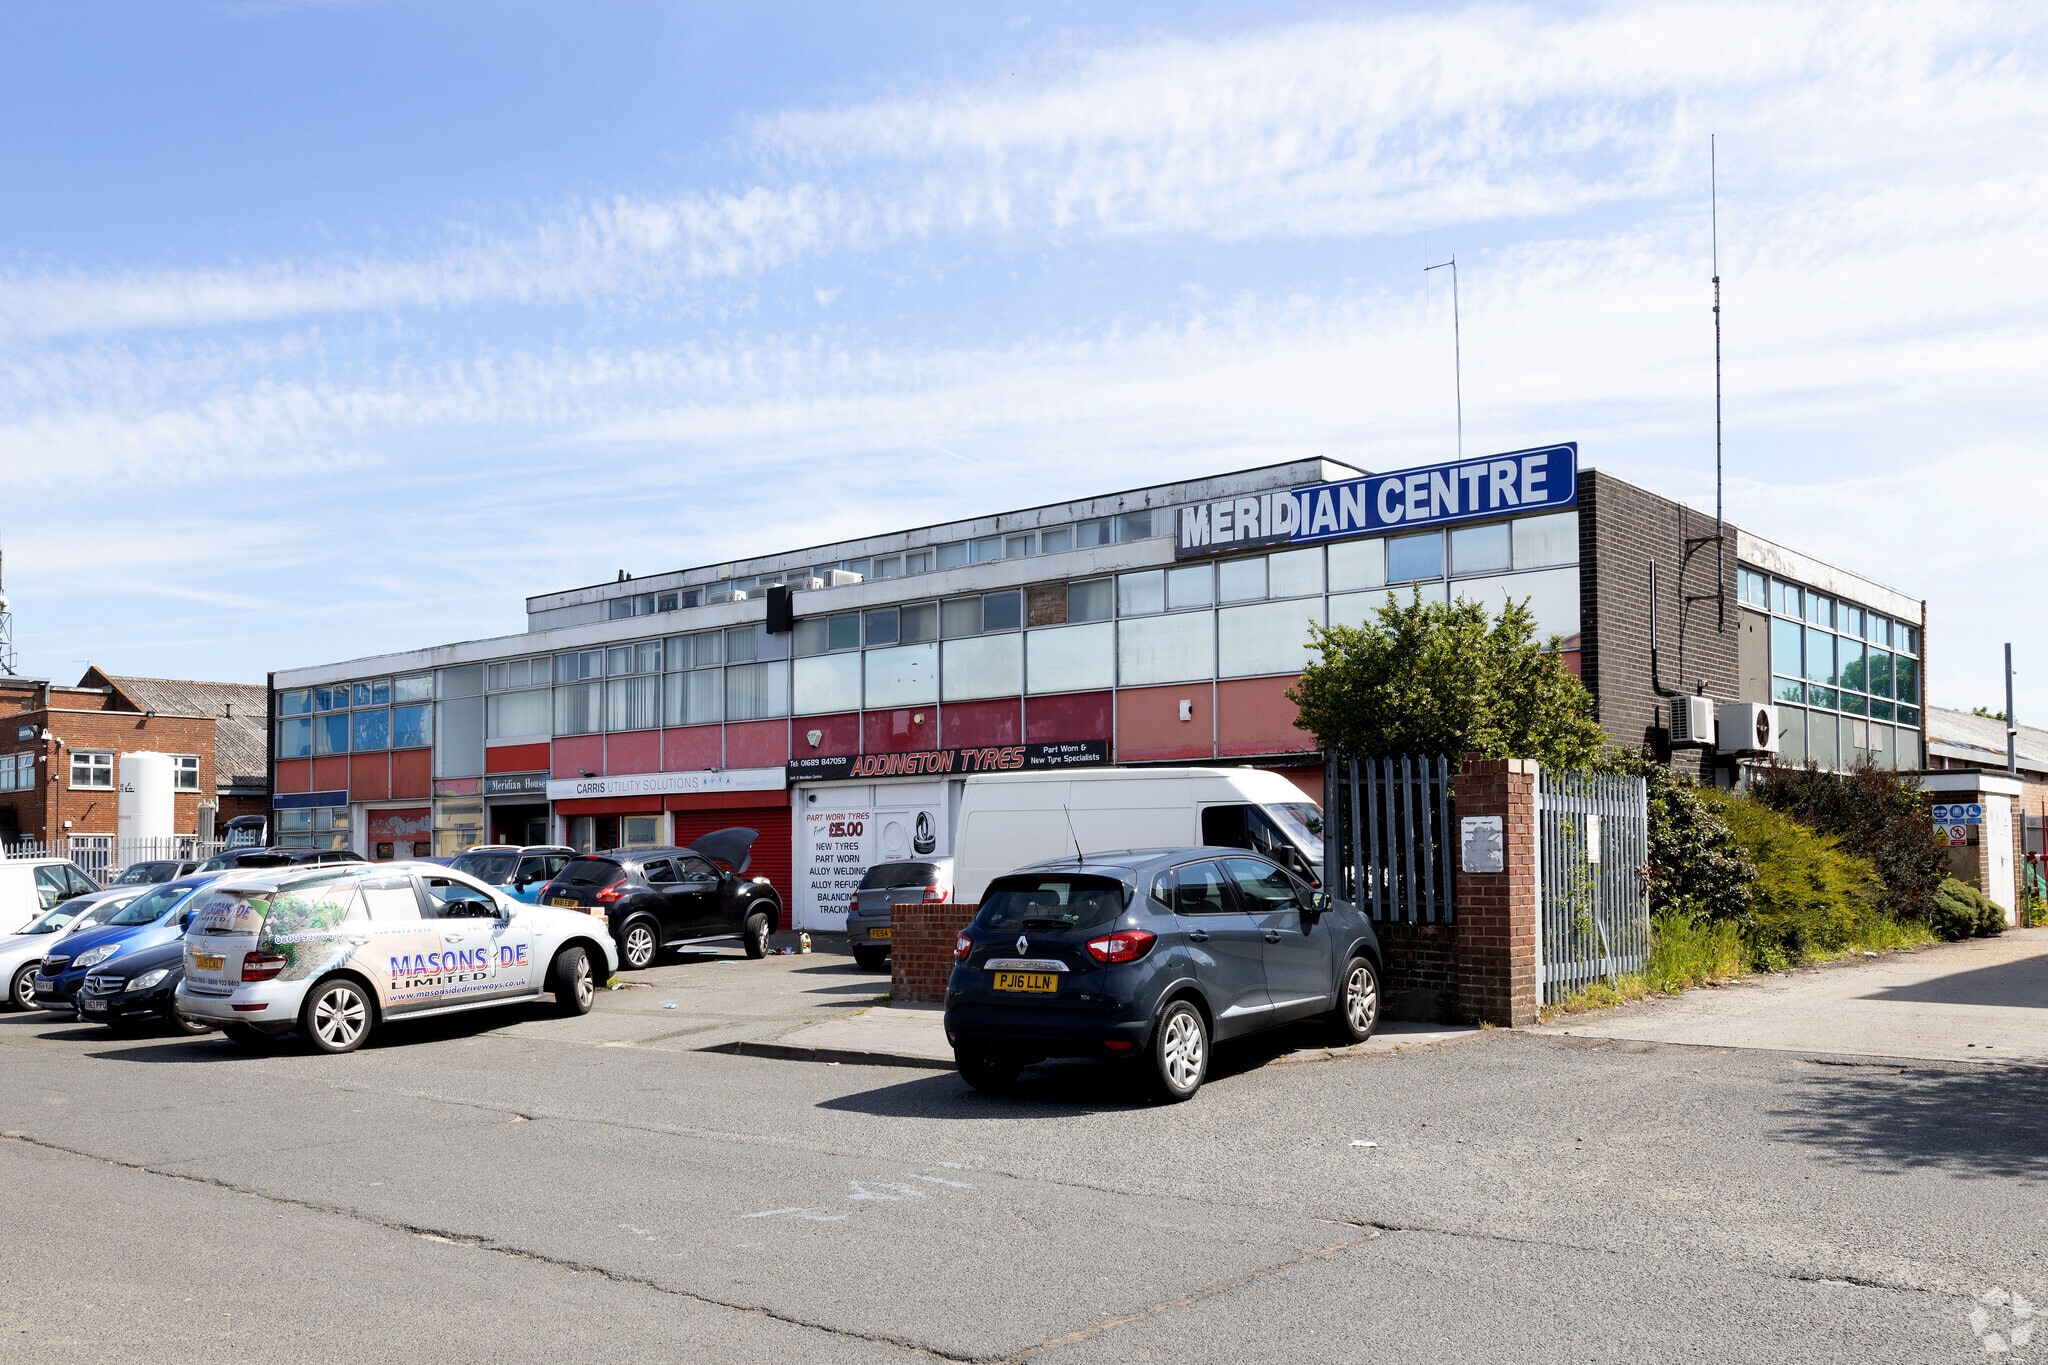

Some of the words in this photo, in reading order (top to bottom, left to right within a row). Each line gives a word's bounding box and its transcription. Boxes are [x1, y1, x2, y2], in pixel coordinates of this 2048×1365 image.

[1181, 483, 1368, 549] MERIDIAN
[1377, 454, 1549, 524] CENTRE
[1043, 746, 1059, 754] Part
[800, 758, 819, 767] 01689
[821, 757, 846, 766] 847059
[850, 751, 955, 776] ADDINGTON
[961, 746, 1026, 771] TYRES
[1047, 756, 1062, 764] Tyre
[1063, 753, 1100, 763] Specialists
[491, 779, 521, 791] Meridian
[525, 778, 546, 789] House
[577, 782, 606, 794] CARRIS
[608, 780, 640, 793] UTILITY
[643, 777, 699, 791] SOLUTIONS
[806, 814, 823, 822] PART
[825, 813, 846, 821] WORN
[848, 812, 870, 820] TYRES
[829, 821, 864, 838] £15.00
[816, 843, 832, 851] NEW
[835, 842, 859, 850] TYRES
[815, 855, 834, 863] PART
[837, 854, 860, 862] WORN
[809, 867, 831, 875] ALLOY
[833, 867, 866, 876] WELDING
[811, 880, 832, 889] ALLOY
[817, 893, 852, 901] BALANCIN
[820, 905, 850, 914] TRACKIN
[872, 929, 889, 937] FE54
[275, 935, 300, 944] 0800
[390, 947, 487, 980] MASONS
[391, 972, 487, 990] LIMITED
[1000, 974, 1025, 988] PJ16
[1027, 976, 1051, 989] LLN
[389, 978, 526, 1001] www.masonsidedriveways.co.uk
